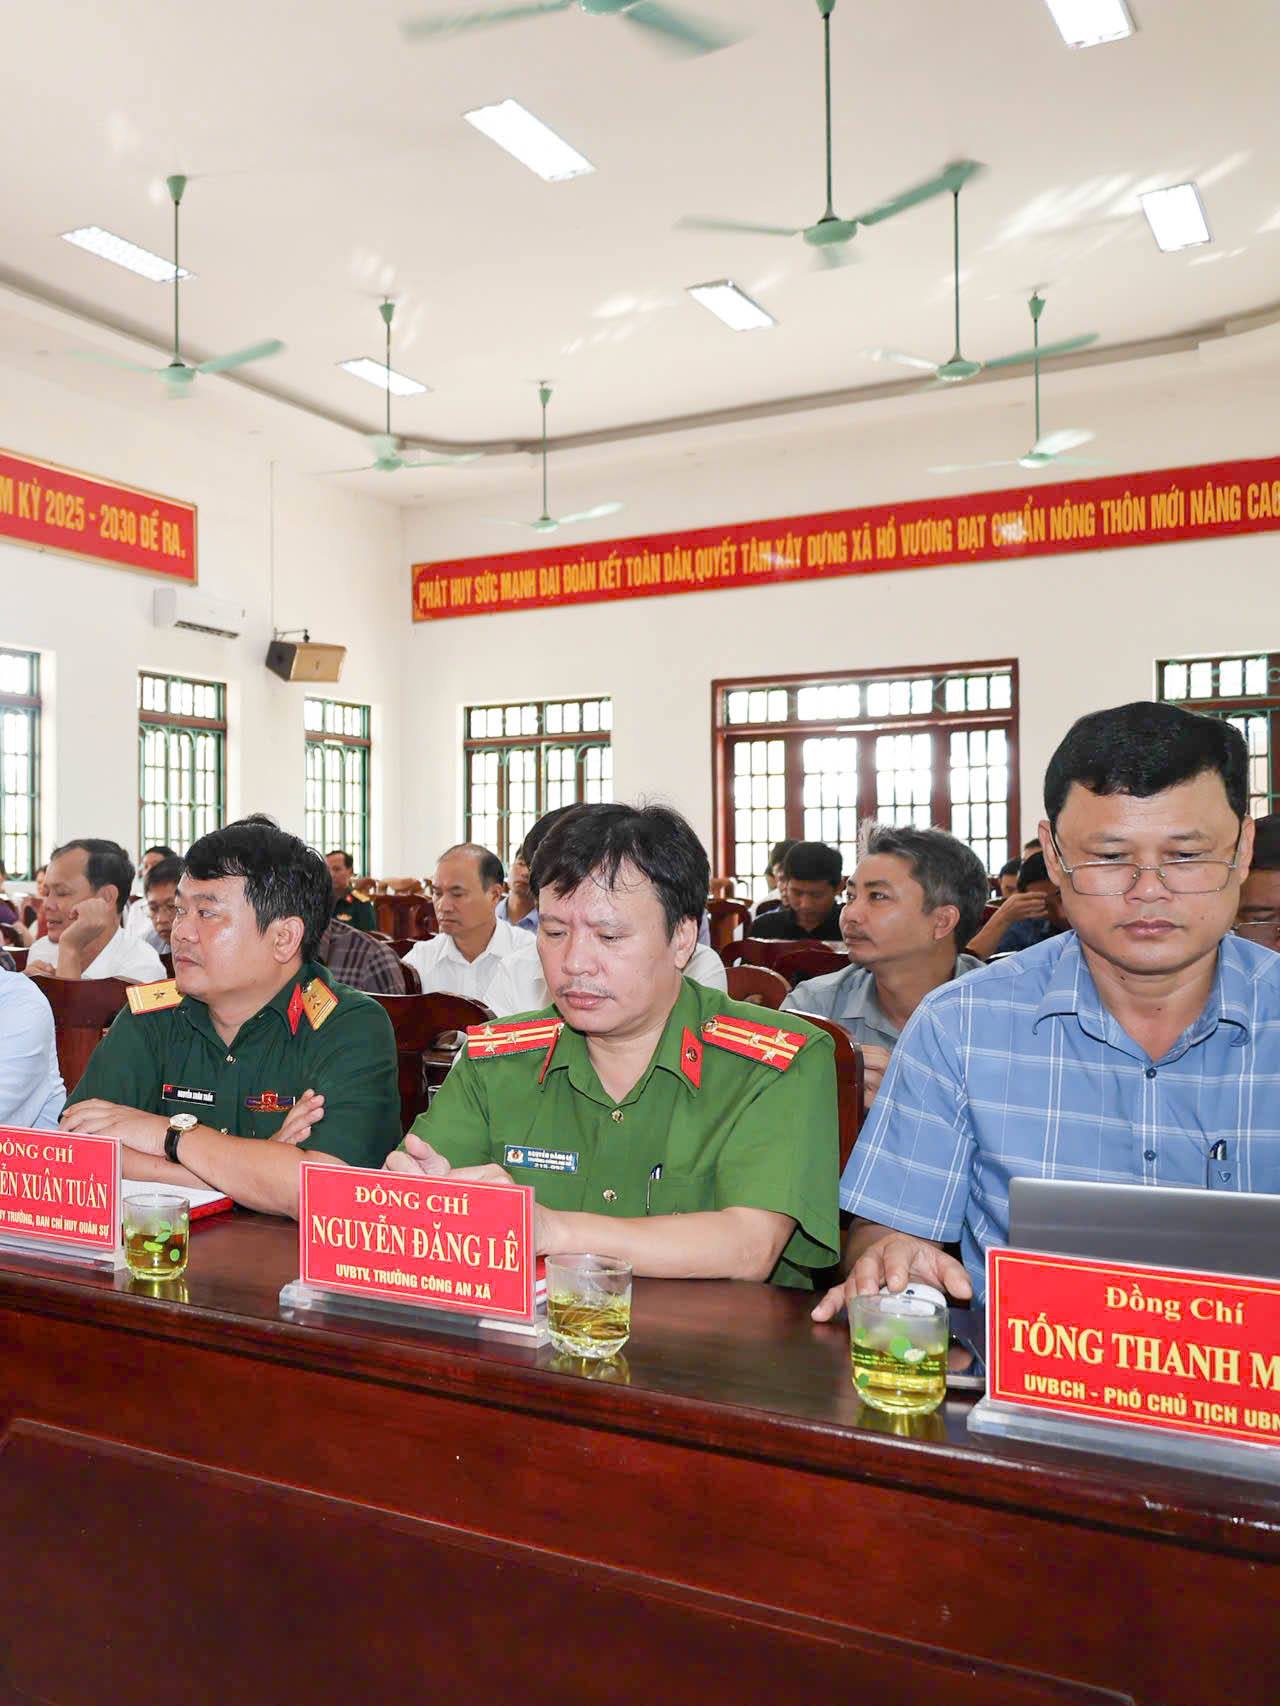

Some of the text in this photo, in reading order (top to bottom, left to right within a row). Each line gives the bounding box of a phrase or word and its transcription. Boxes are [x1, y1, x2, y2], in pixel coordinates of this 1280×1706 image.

[45, 490, 86, 532] 2025
[100, 504, 137, 545] 2030
[162, 521, 187, 559] RA.
[420, 574, 448, 609] PHÁT
[450, 576, 472, 607] HUY
[475, 570, 498, 604] SỨC
[501, 569, 536, 603] MẠNH
[563, 556, 596, 593] ĐOÀN
[599, 549, 622, 589] KẾT
[625, 549, 661, 587] TOÀN
[741, 536, 772, 574] TÂM
[807, 530, 847, 570] DỰNG
[851, 521, 872, 562] XÃ
[900, 518, 953, 556] VƯƠNG
[957, 514, 987, 554] ĐẠT
[1050, 499, 1096, 541] NÔNG
[1100, 491, 1146, 535] THÔN
[1150, 484, 1185, 529] MỚI
[1190, 481, 1241, 525] NÂNG
[42, 1144, 74, 1163] CHÍ
[22, 1168, 63, 1203] XUÂN
[66, 1174, 108, 1211] TUẤN
[354, 1184, 470, 1216] ĐỒNG CHÍ
[35, 1215, 50, 1228] BAN
[311, 1214, 520, 1272] NGUYỄN ĐĂNG LÊ
[373, 1268, 418, 1288] TRƯỞNG
[420, 1274, 453, 1294] CÔNG
[455, 1280, 472, 1297] AN
[474, 1283, 492, 1300] XÃ
[1104, 1283, 1245, 1325] Đồng Chí
[1008, 1312, 1104, 1365] TỐNG
[1112, 1333, 1241, 1386] THANH
[1024, 1374, 1086, 1401] UVBCH
[1148, 1392, 1187, 1416] CHỦ
[1192, 1400, 1238, 1424] TỊCH
